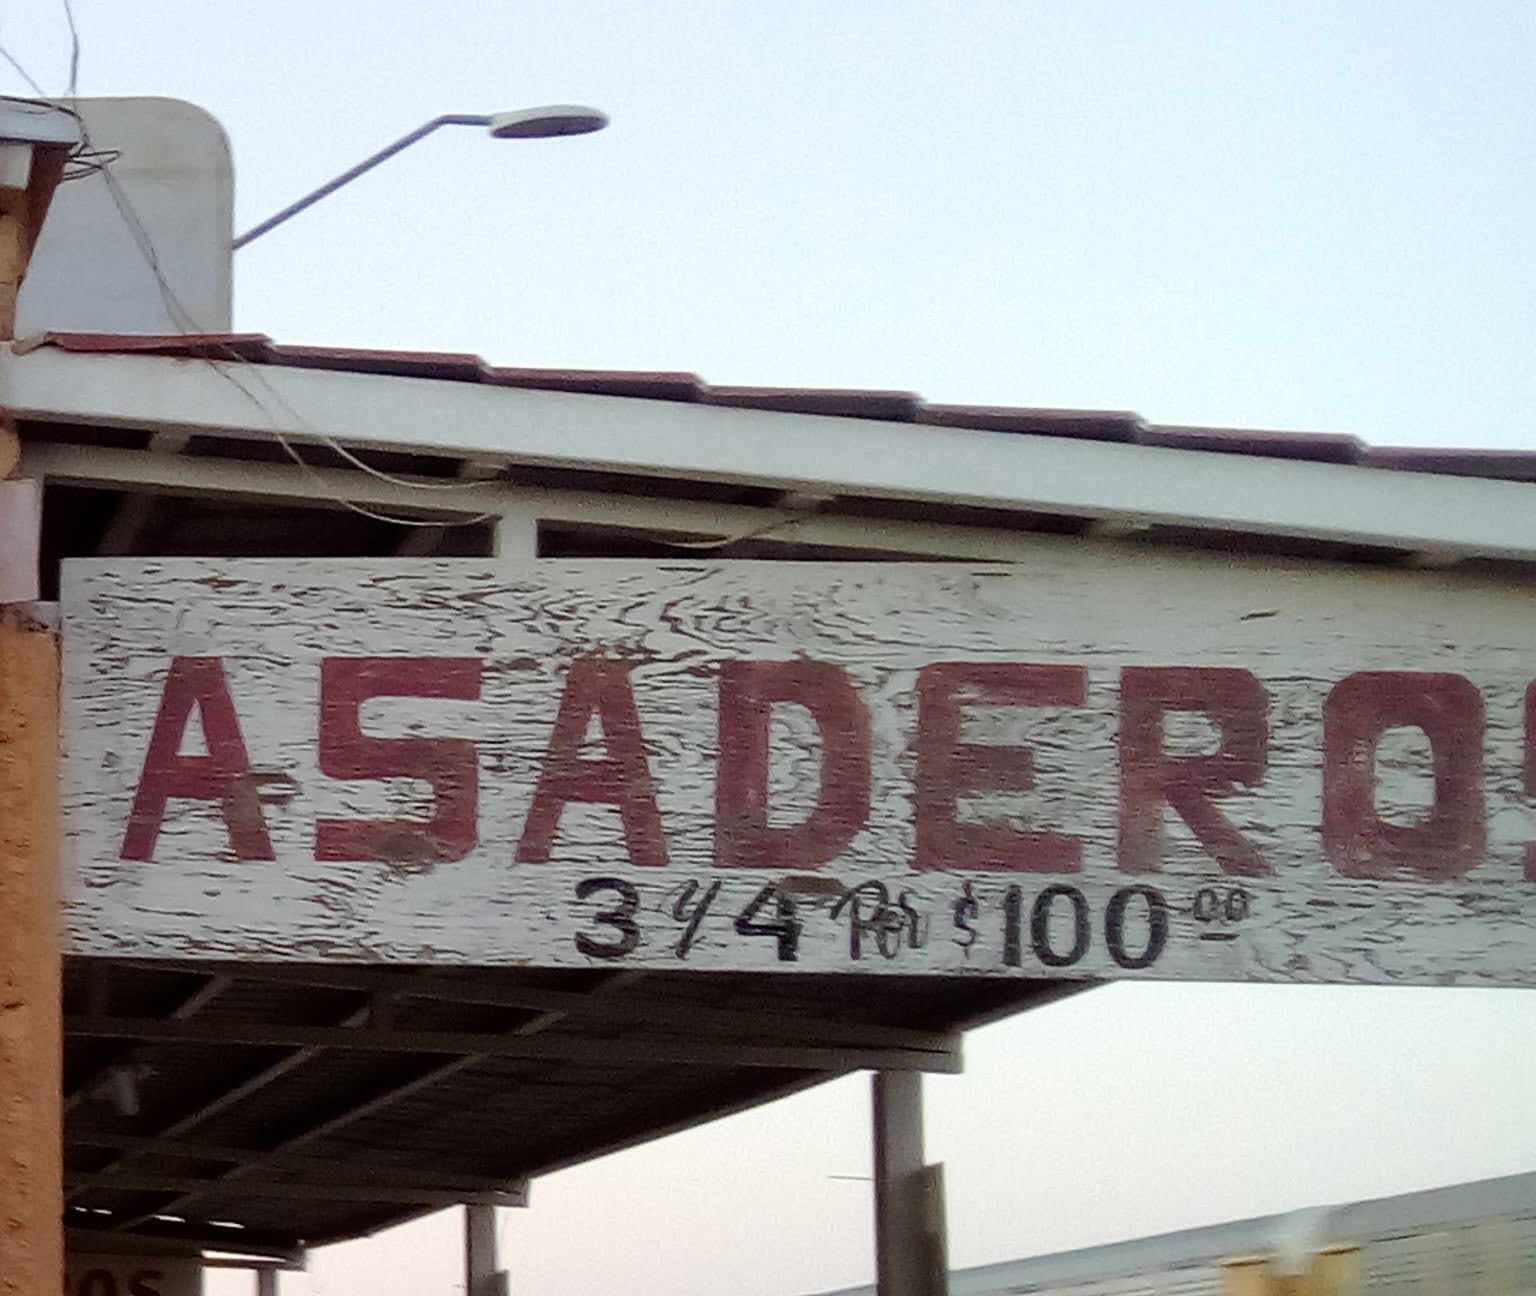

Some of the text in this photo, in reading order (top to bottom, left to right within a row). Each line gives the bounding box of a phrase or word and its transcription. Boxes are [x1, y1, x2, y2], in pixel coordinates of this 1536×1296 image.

[119, 655, 1536, 882] ASADERO
[574, 876, 640, 960] 3
[734, 883, 801, 963] 4
